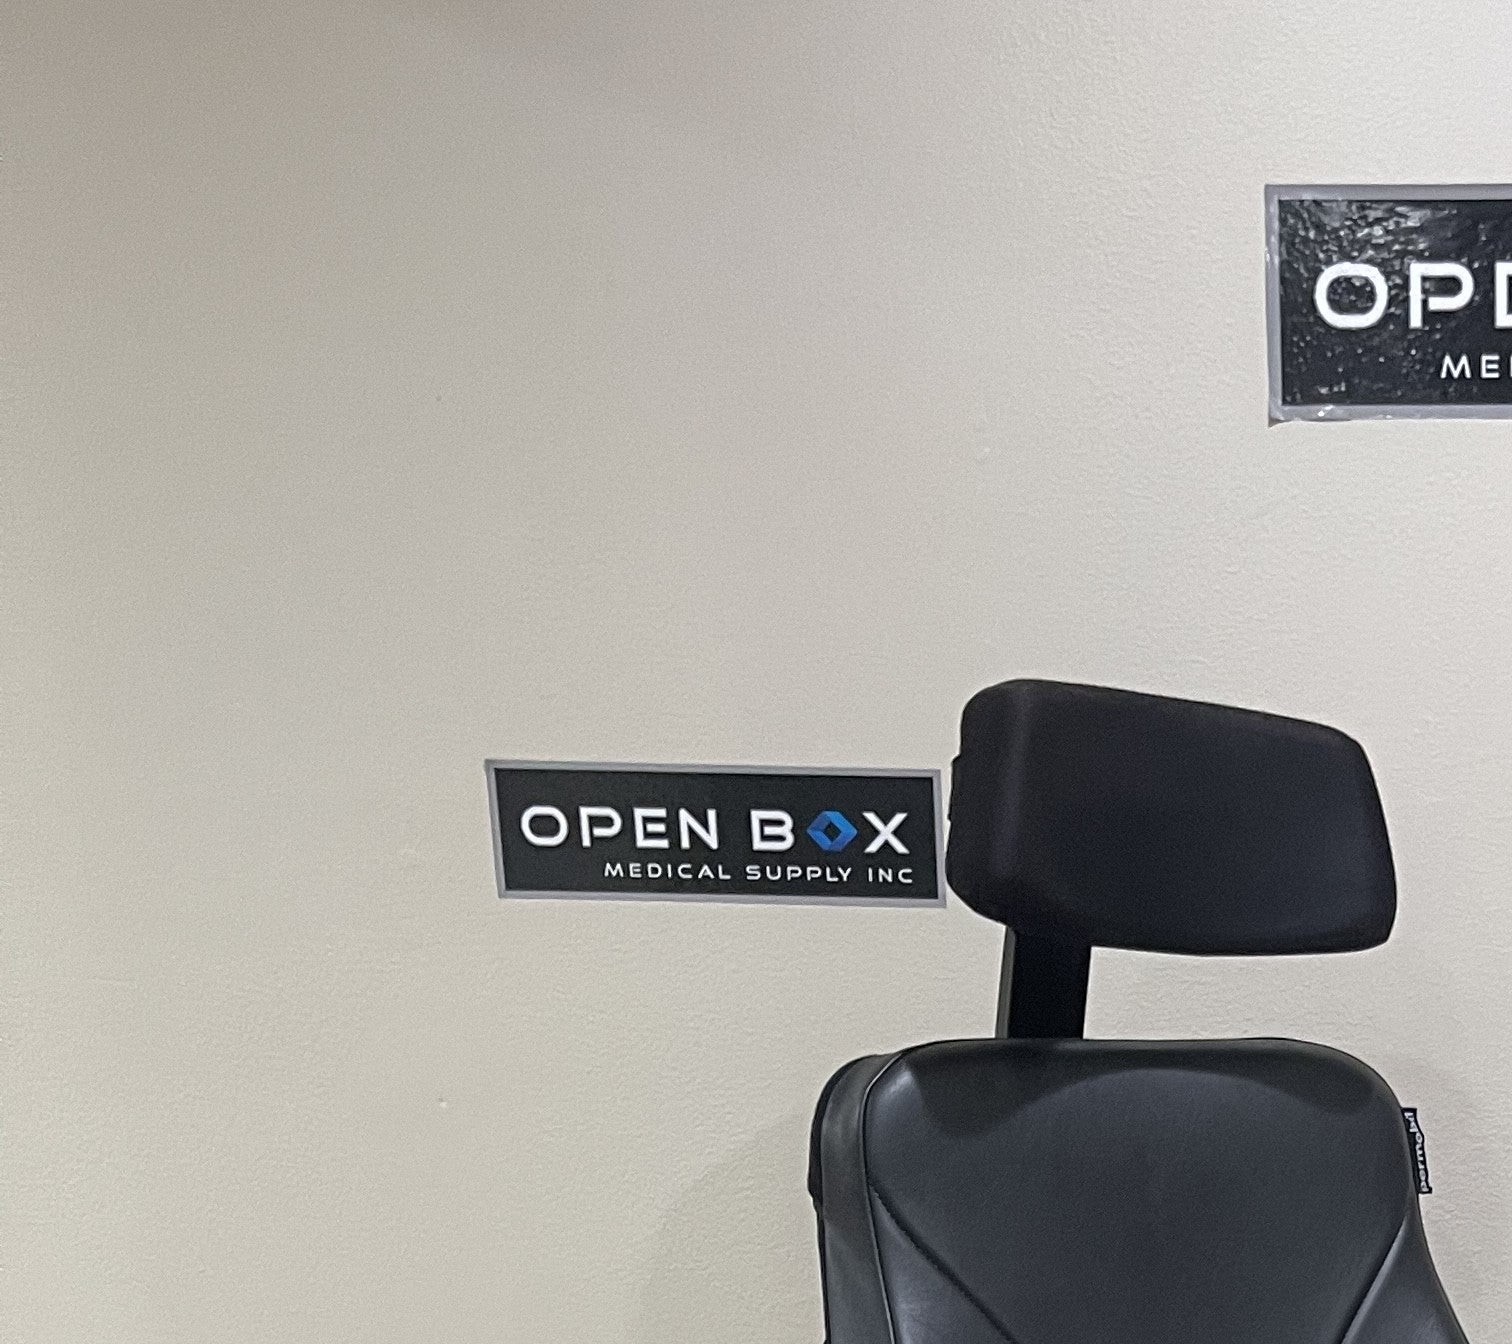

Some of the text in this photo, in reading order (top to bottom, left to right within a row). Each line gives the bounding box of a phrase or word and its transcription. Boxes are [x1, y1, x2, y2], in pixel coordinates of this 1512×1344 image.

[520, 805, 910, 854] OPEN BOX
[604, 862, 913, 884] MEDICAL SUPPLY INC
[1404, 1112, 1429, 1192] permobil
